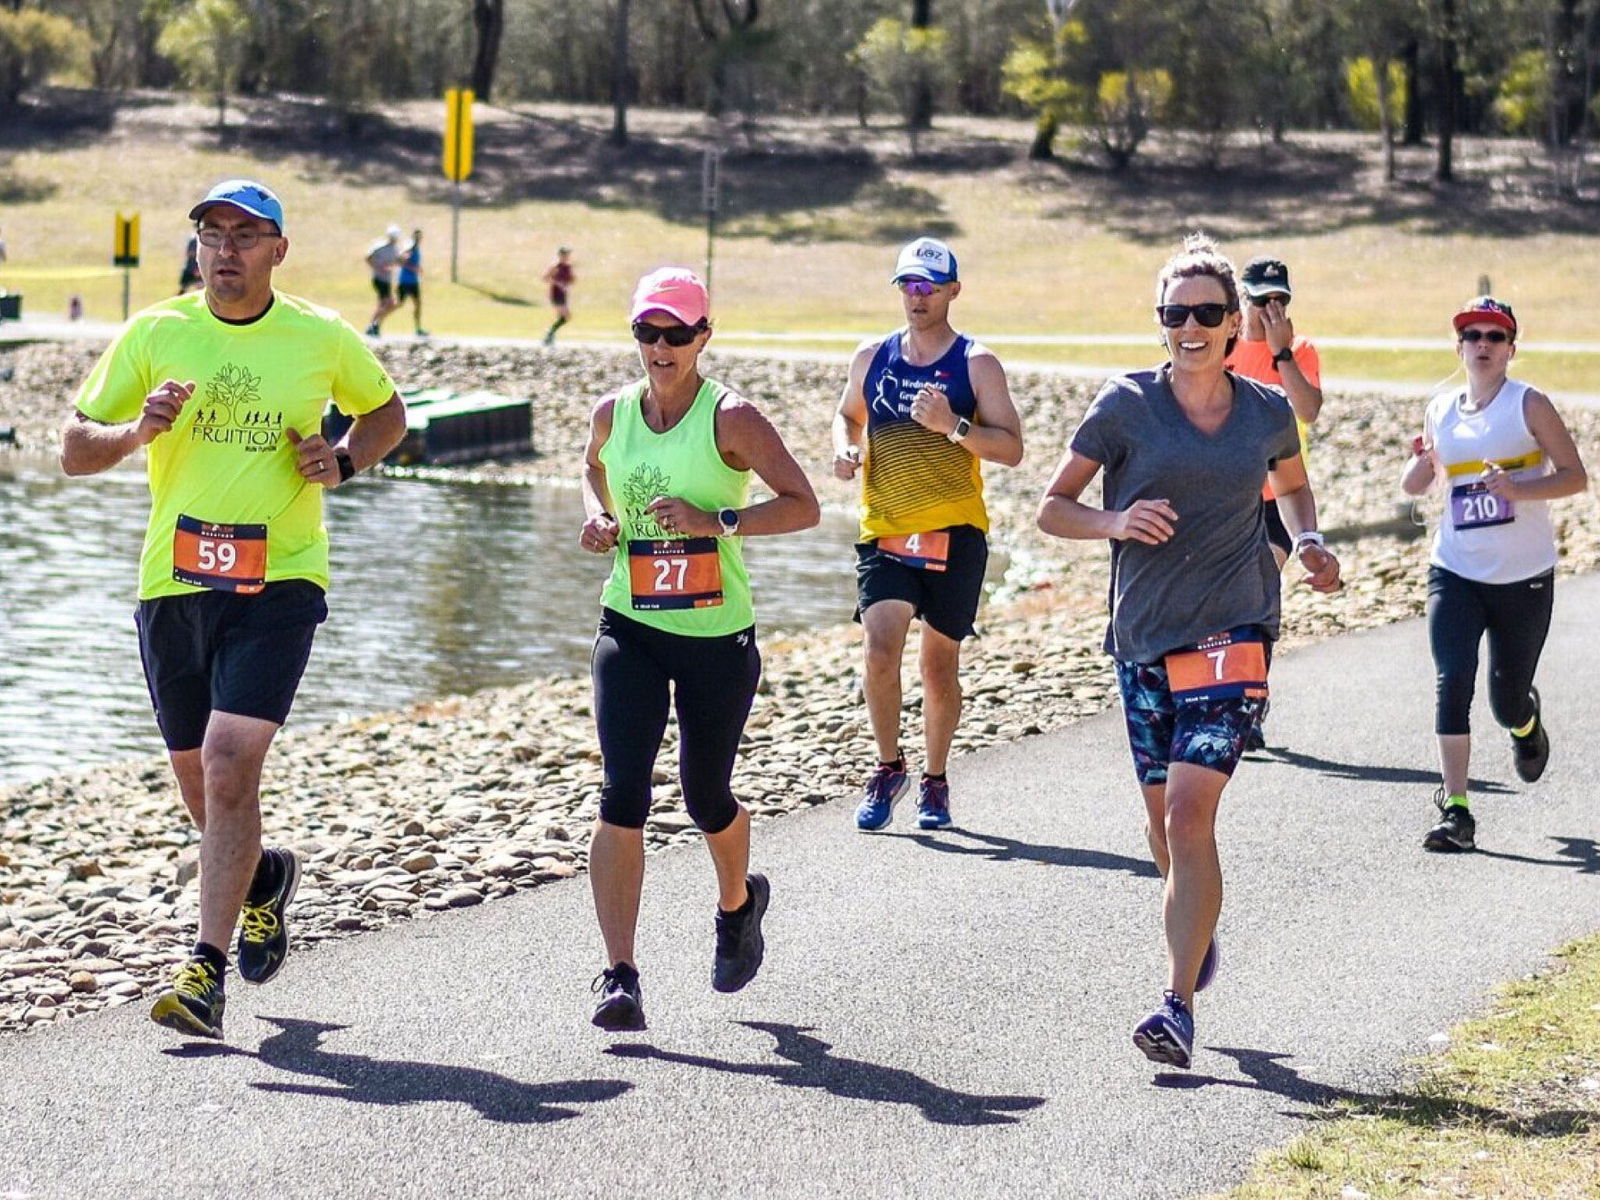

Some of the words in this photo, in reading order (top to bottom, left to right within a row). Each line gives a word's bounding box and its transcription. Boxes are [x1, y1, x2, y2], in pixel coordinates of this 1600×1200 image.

[902, 379, 947, 391] Wednday
[191, 426, 281, 445] FRUITION
[1462, 495, 1497, 521] 210
[198, 539, 236, 572] 59
[905, 533, 920, 554] 4
[653, 558, 688, 591] 27
[1207, 650, 1226, 680] 7
